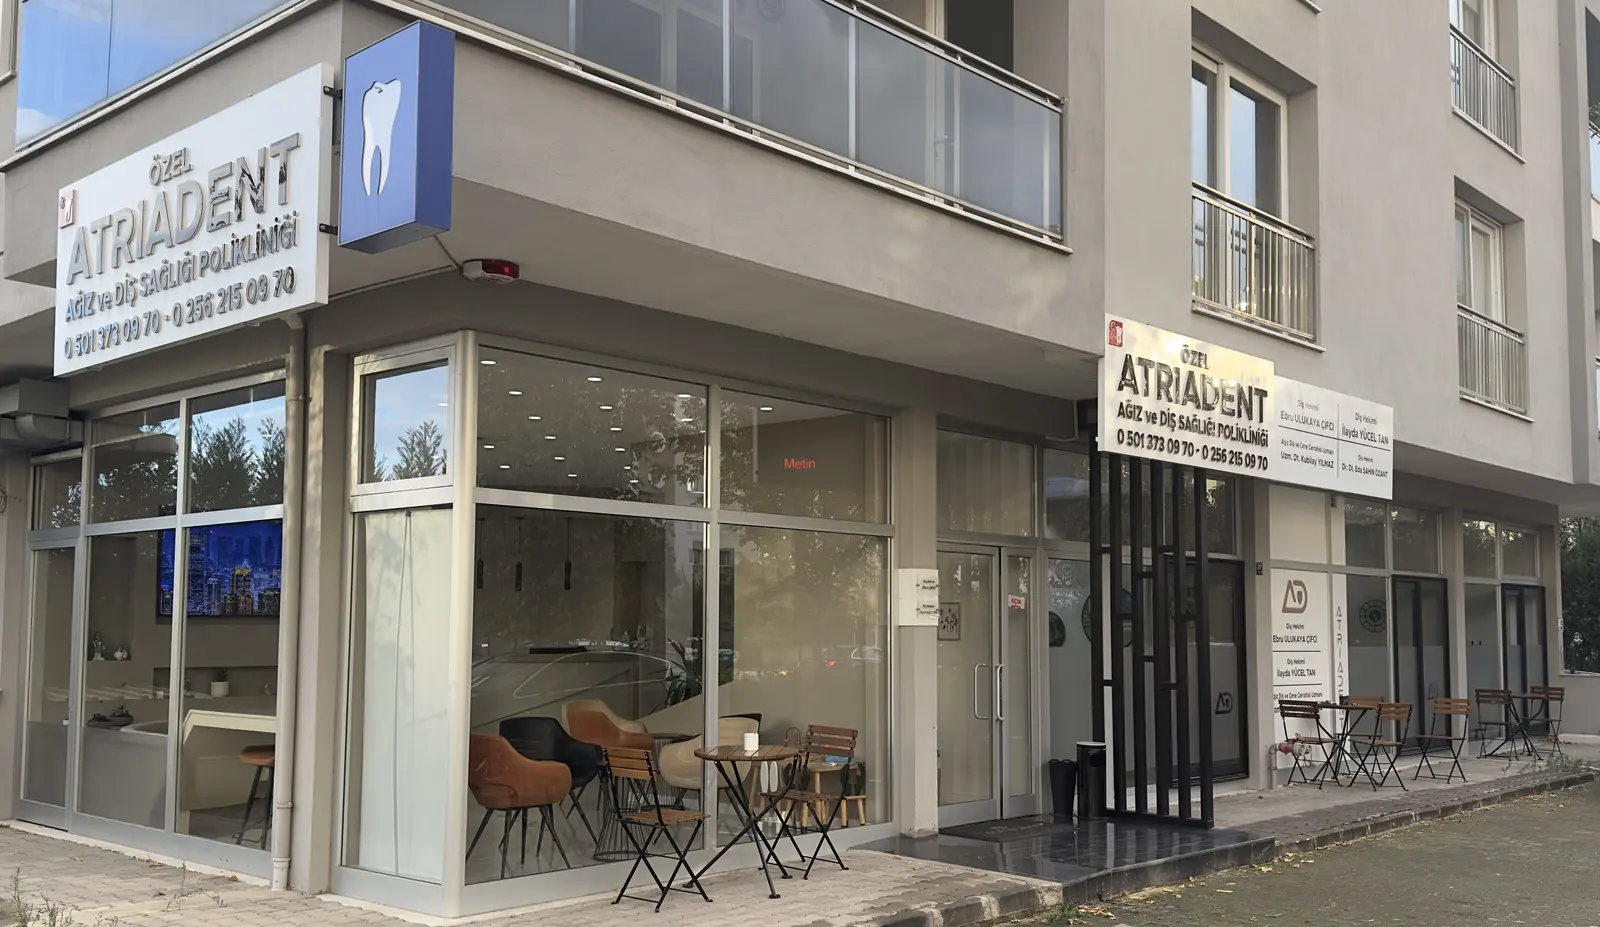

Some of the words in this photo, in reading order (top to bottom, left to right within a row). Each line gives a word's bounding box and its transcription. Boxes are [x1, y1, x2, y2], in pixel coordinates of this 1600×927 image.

[150, 147, 192, 186] ÖZEL
[66, 132, 301, 285] ATRIADENT
[65, 289, 95, 322] AĞIZ
[98, 294, 112, 310] ve
[114, 274, 138, 307] DİŞ
[139, 249, 196, 297] SAĞLIĞI
[199, 210, 299, 277] POLİKLİNİĞİ
[64, 336, 73, 359] 0
[75, 328, 96, 356] 501
[97, 322, 121, 349] 373
[123, 315, 140, 343] 09
[142, 309, 161, 337] 70
[172, 302, 183, 327] 0
[185, 292, 214, 323] 256
[216, 282, 243, 314] 215
[246, 274, 269, 305] 09
[272, 266, 297, 298] 70
[1180, 344, 1210, 370] ÖZEL
[1117, 353, 1268, 423] ATRIADENT
[1117, 399, 1142, 422] AĞIZ
[1145, 410, 1158, 424] ve
[1159, 407, 1177, 432] DİŞ
[1178, 412, 1216, 436] SAĞLIĞI
[1218, 422, 1269, 448] POLİKLİNİĞİ
[1280, 410, 1294, 422] Ebru
[1294, 413, 1321, 428] ULUKAYA
[1362, 414, 1377, 425] Hekimi
[1341, 423, 1359, 438] İlayda
[1359, 427, 1377, 443] YÜCEL
[1377, 433, 1389, 445] TAN
[1117, 428, 1124, 445] 0
[1127, 430, 1145, 449] 501
[1146, 434, 1165, 452] 373
[1167, 439, 1181, 455] 09
[1182, 441, 1194, 457] 70
[1202, 444, 1209, 459] 0
[1210, 446, 1227, 463] 256
[1228, 450, 1243, 466] 215
[1244, 454, 1256, 468] 09
[1257, 455, 1268, 471] 70
[1280, 450, 1293, 461] Uzm.
[1300, 455, 1317, 467] Kubilay
[1317, 458, 1334, 469] YILMAZ
[1354, 465, 1362, 474] Eda
[1272, 634, 1284, 643] Ebru
[1284, 635, 1306, 643] ULUKAYA
[1291, 667, 1306, 677] YÜCEL
[1306, 668, 1316, 677] TAN
